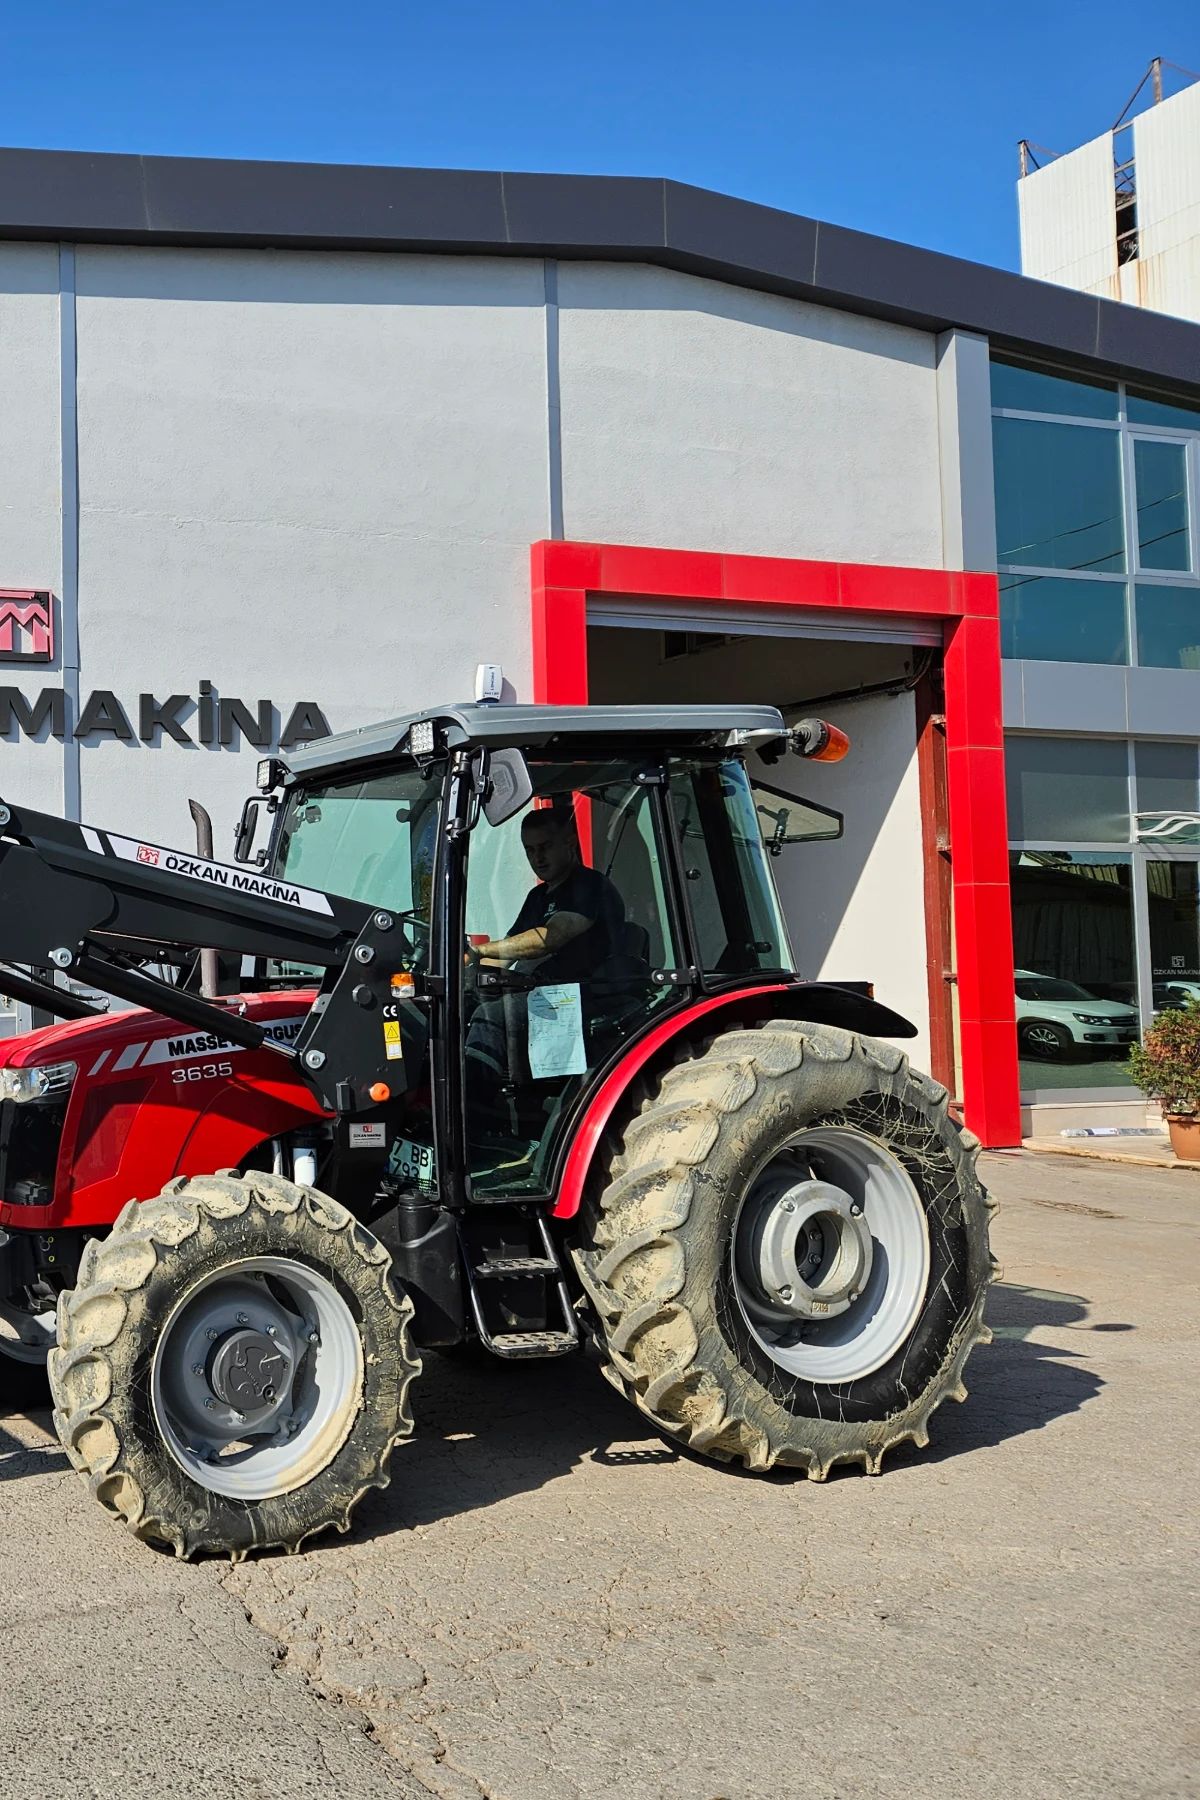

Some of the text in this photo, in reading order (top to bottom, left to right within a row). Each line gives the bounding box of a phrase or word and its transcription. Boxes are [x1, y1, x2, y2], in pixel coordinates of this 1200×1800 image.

[165, 854, 229, 884] ÖZKAN
[231, 873, 302, 906] MAKİNA
[171, 1061, 233, 1084] 3635
[411, 1144, 430, 1168] BB
[393, 1157, 421, 1180] 793
